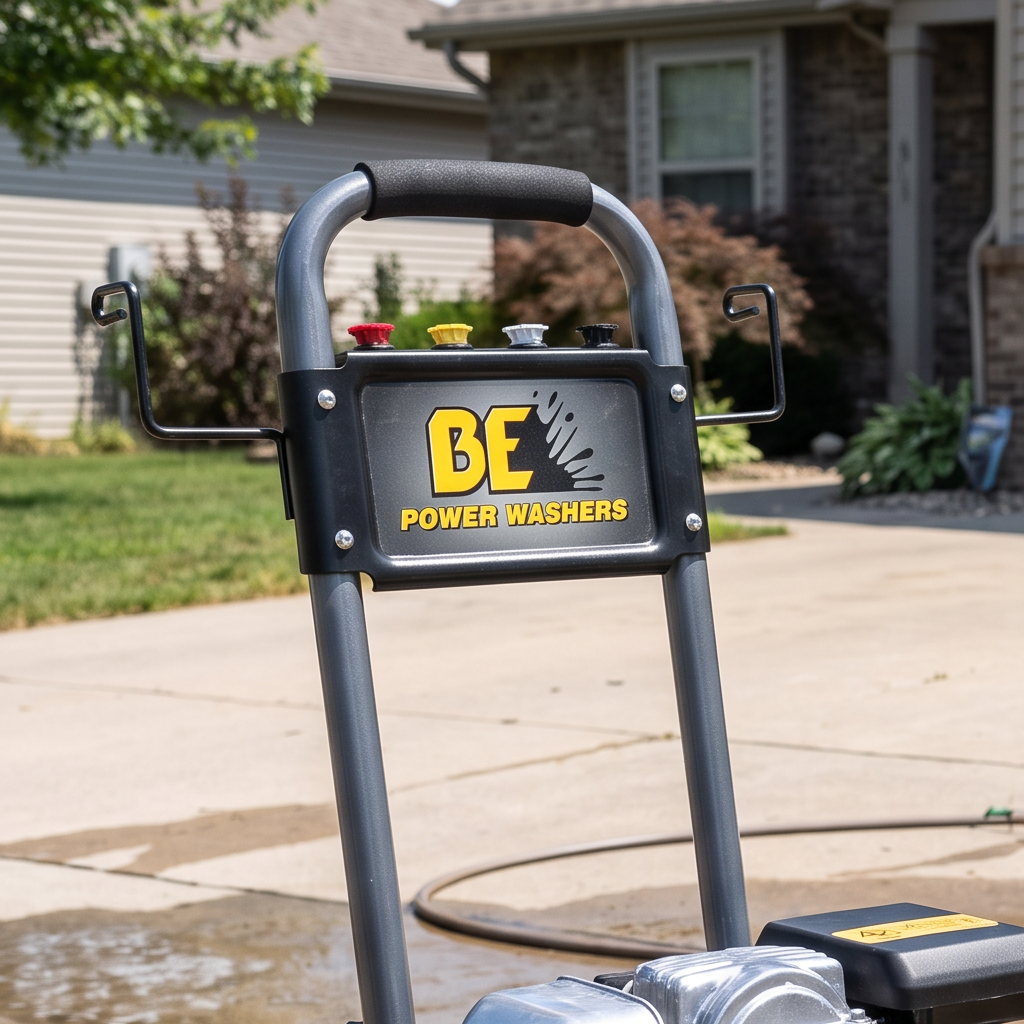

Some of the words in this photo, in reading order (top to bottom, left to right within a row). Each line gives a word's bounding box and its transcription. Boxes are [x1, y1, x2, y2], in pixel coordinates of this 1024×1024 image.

[426, 405, 535, 496] BE
[400, 504, 498, 531] POWER
[505, 498, 628, 526] WASHERS
